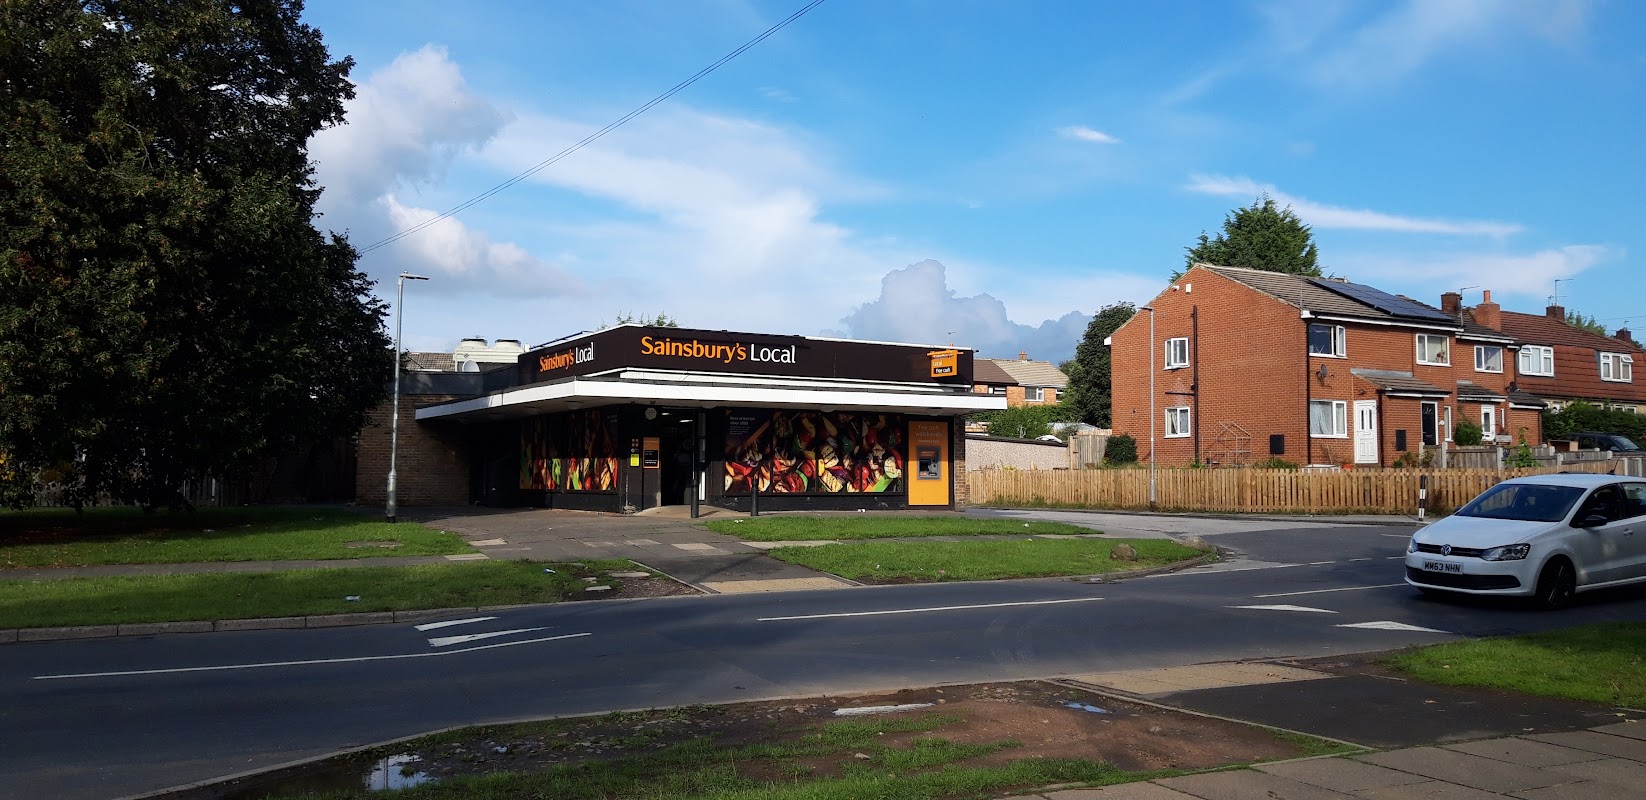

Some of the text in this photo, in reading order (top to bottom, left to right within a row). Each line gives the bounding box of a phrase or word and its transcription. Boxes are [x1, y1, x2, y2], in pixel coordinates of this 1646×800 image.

[539, 342, 594, 372] Sainsbury's Local
[641, 336, 796, 363] Sainsbury's Local
[1424, 561, 1461, 573] MM63 NHN
